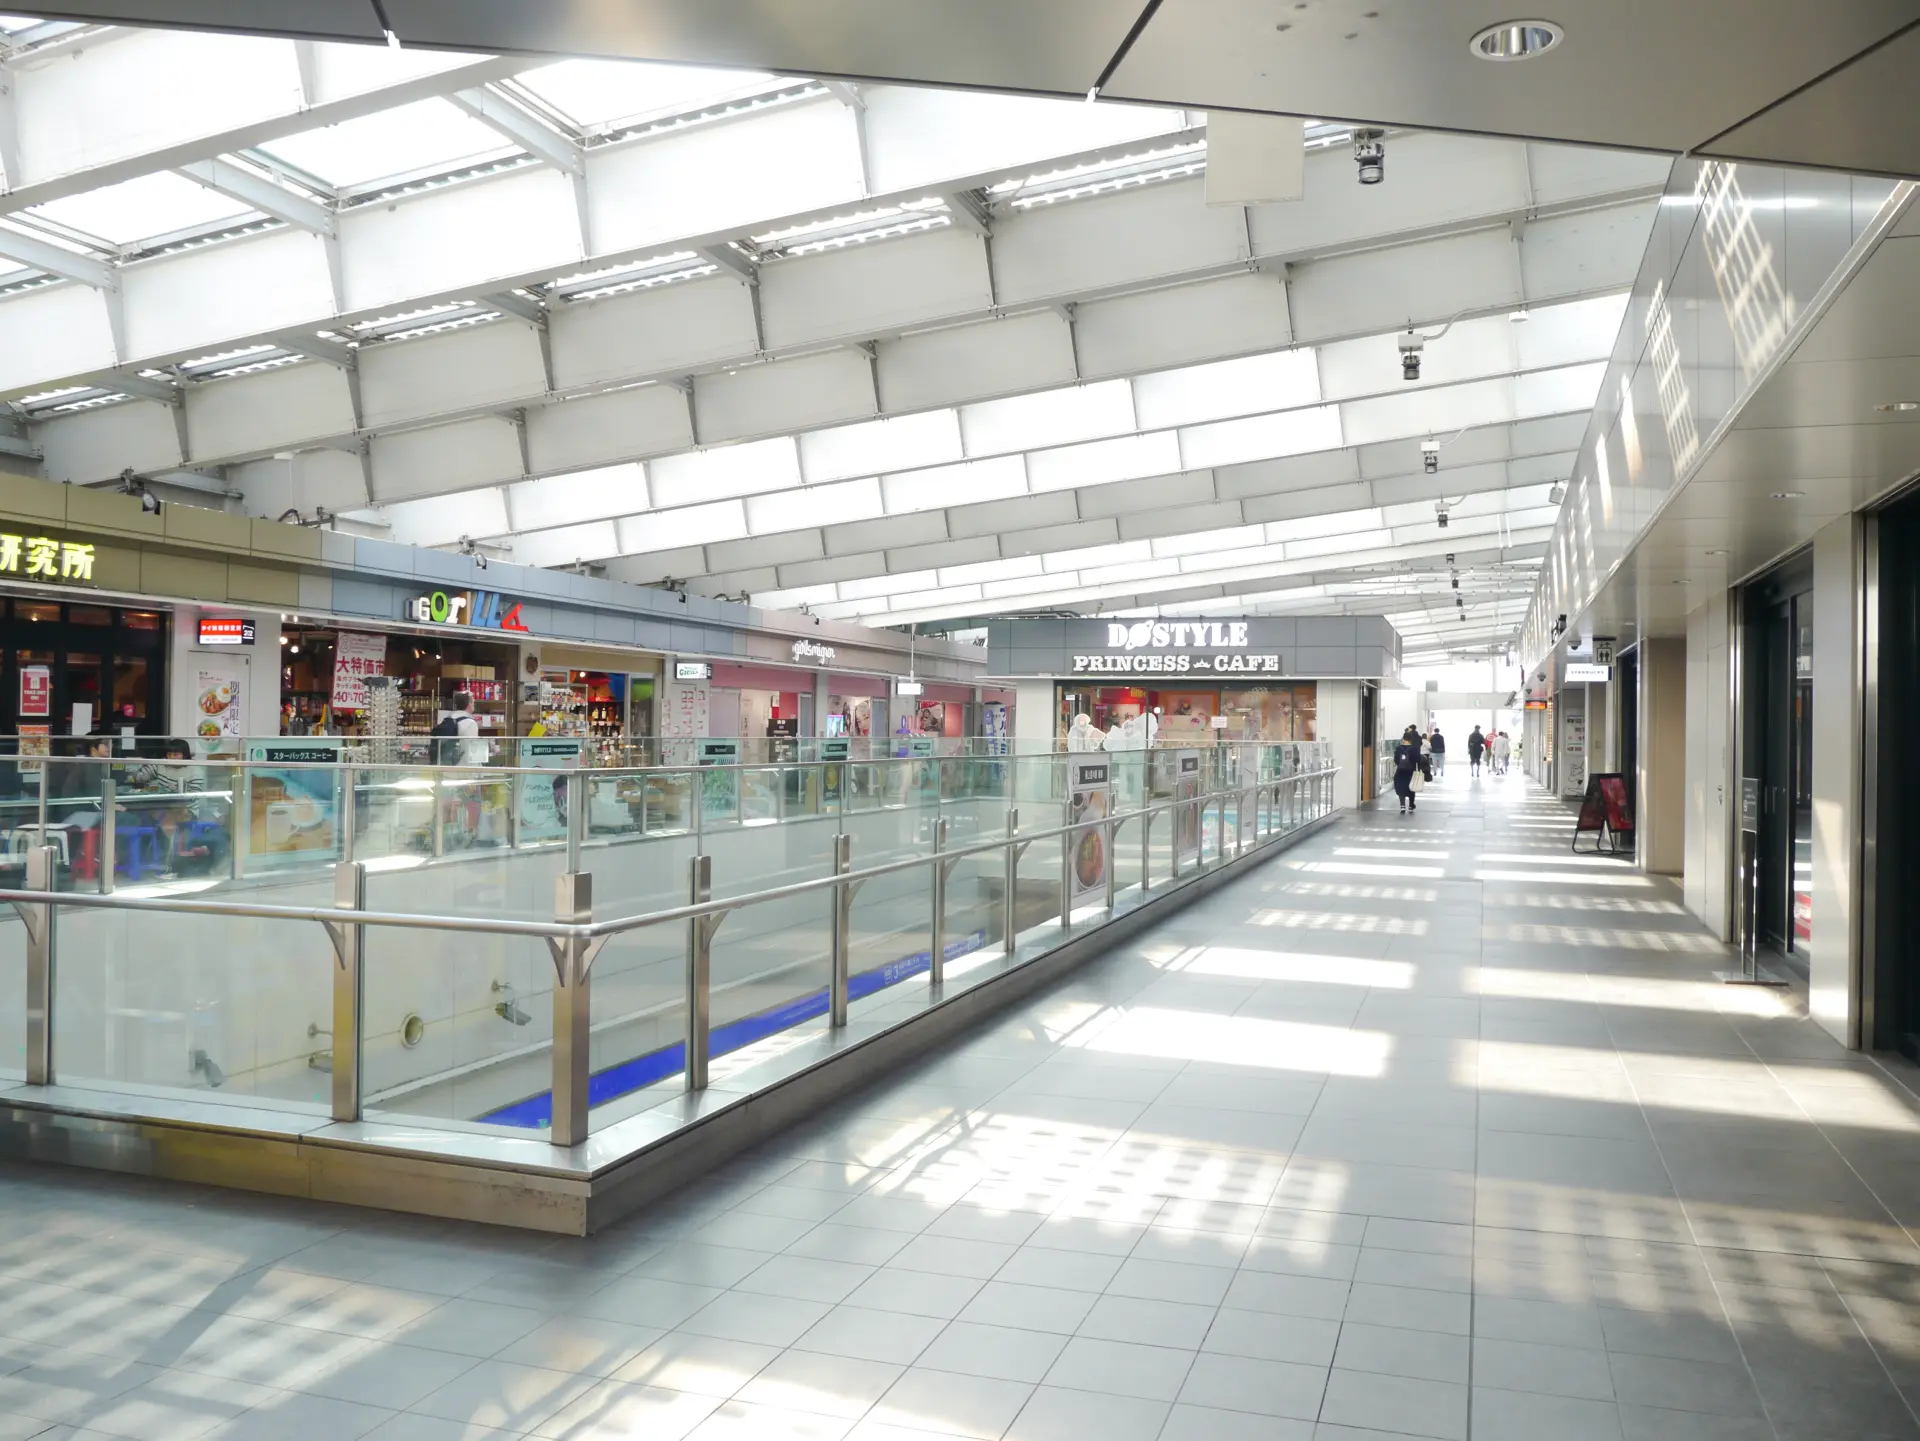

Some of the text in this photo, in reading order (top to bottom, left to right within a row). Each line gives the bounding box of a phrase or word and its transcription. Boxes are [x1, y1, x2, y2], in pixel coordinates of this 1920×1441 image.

[336, 656, 385, 676] 大特価市
[1073, 655, 1279, 672] PRINCESS CAFE
[273, 752, 332, 760] スターバックス コーヒー
